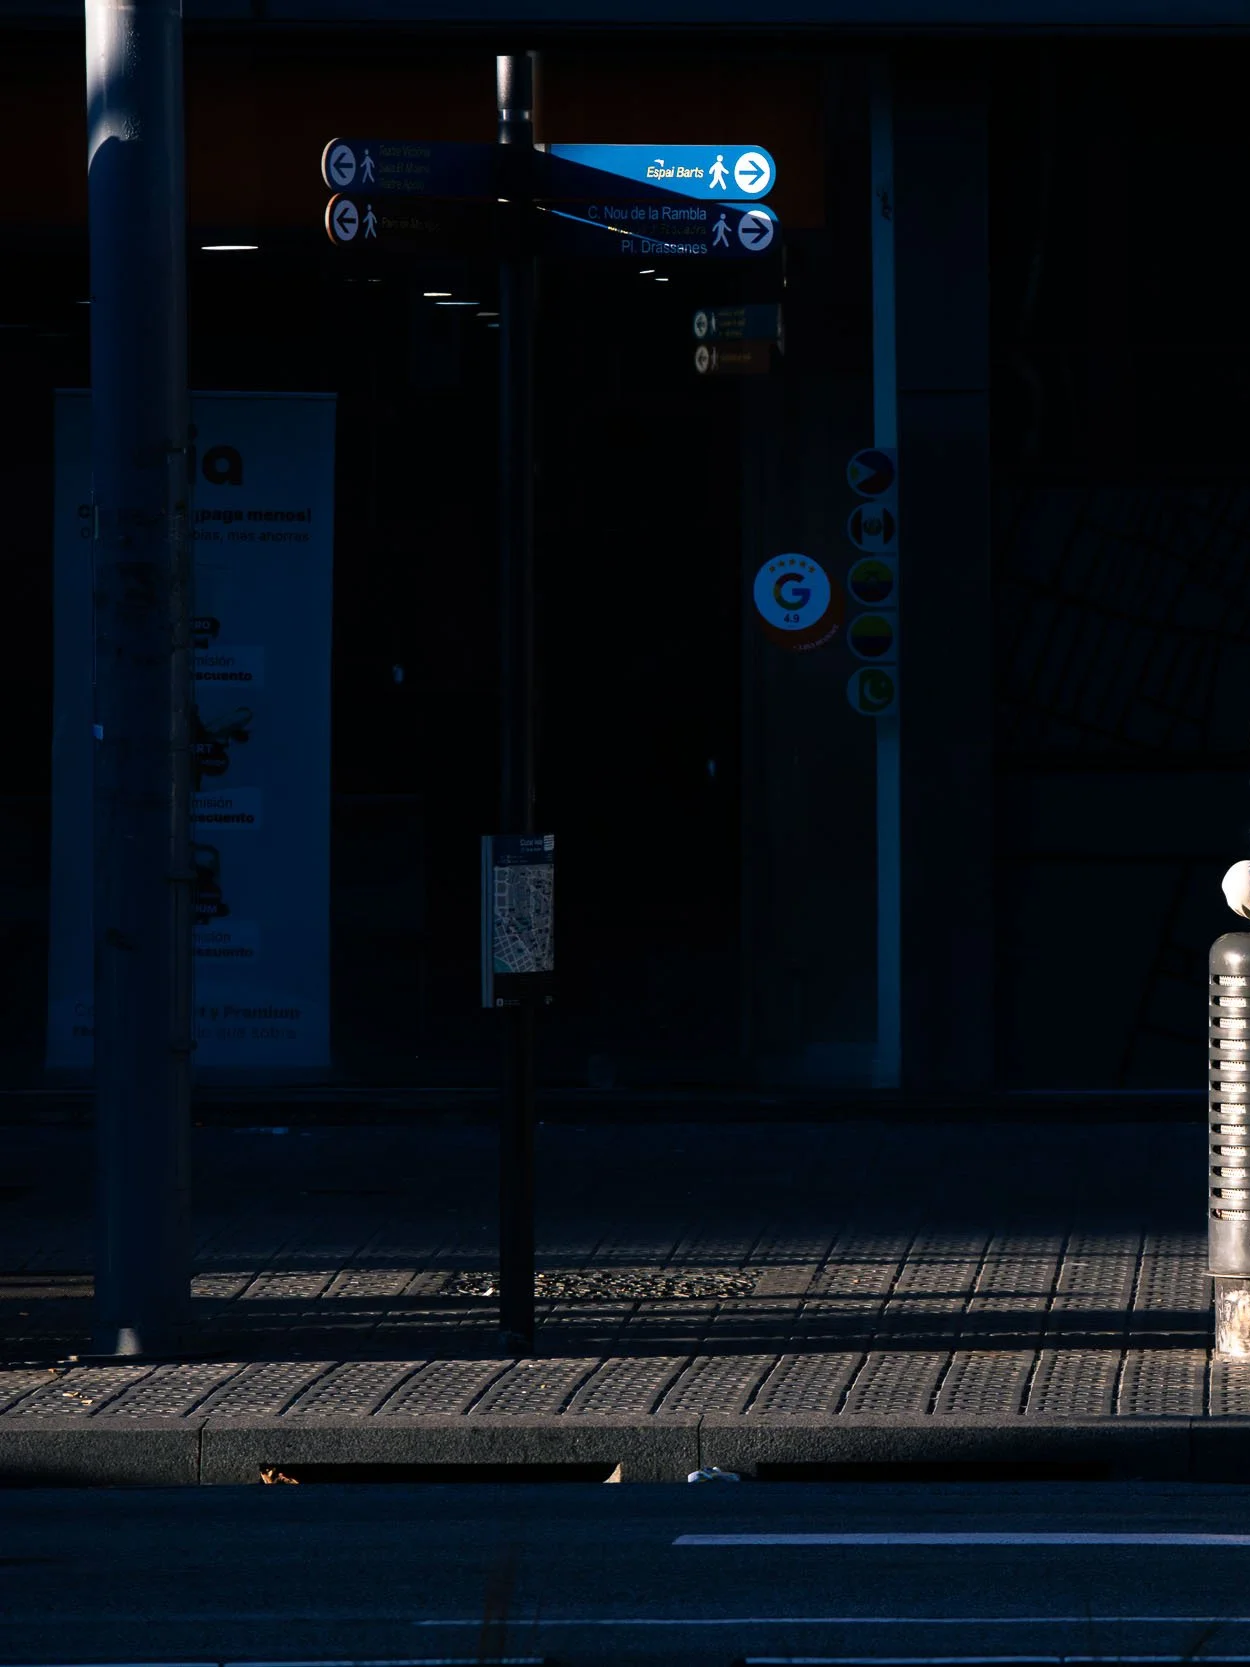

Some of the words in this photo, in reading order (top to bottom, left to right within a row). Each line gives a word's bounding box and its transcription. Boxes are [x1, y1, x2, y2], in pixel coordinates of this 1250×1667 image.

[646, 166, 675, 180] Espai
[676, 166, 704, 179] Barts
[588, 205, 600, 219] C.
[604, 205, 628, 219] Nou
[631, 205, 646, 219] de
[648, 206, 659, 220] la
[661, 206, 707, 220] Rambla
[621, 240, 637, 253] Pl.
[641, 240, 708, 255] Drassanes
[774, 572, 810, 611] G
[193, 652, 235, 667] misión
[192, 797, 233, 809] misión
